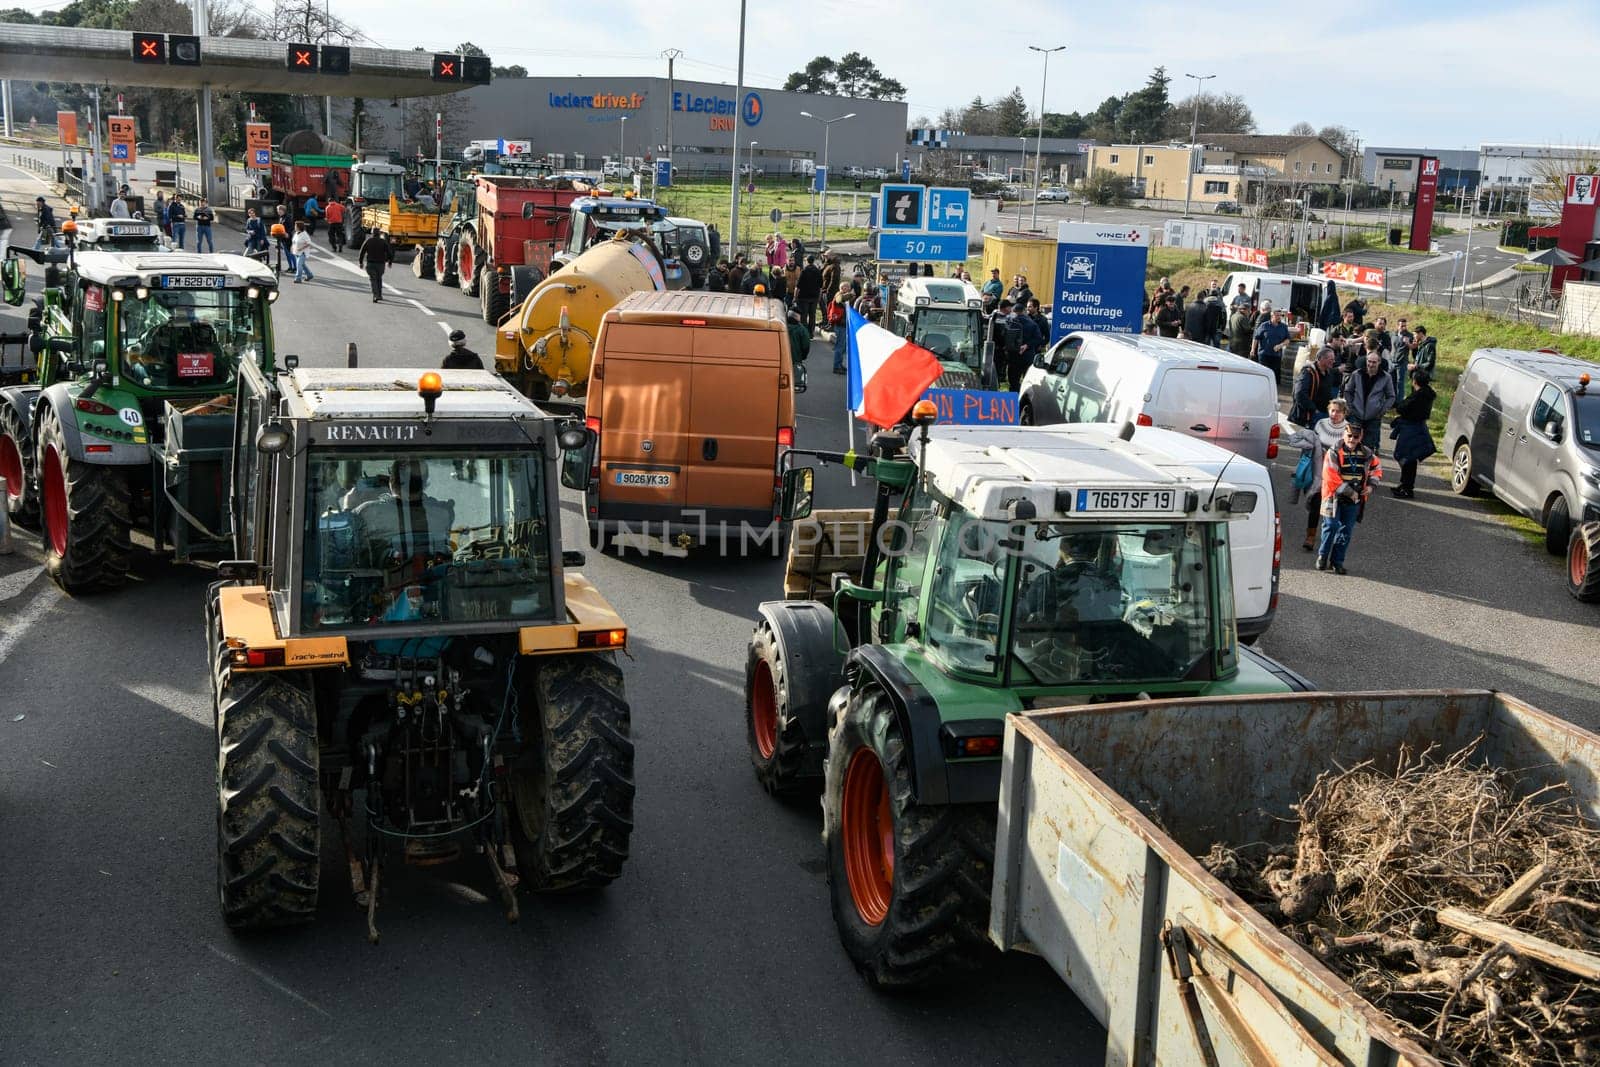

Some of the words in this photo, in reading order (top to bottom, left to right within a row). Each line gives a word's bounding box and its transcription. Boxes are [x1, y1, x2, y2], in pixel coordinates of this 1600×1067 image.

[548, 92, 645, 109] leclercdrive.fr
[709, 116, 736, 132] DRIV
[905, 240, 926, 255] 50
[929, 243, 943, 255] m
[1365, 271, 1383, 284] KFC
[1062, 291, 1102, 306] Parking
[1061, 303, 1123, 320] covoiturage
[1059, 322, 1082, 331] Gratuit
[1102, 324, 1110, 332] 72
[964, 393, 1015, 423] PLAN
[123, 410, 140, 424] 40
[326, 425, 418, 440] RENAULT
[623, 474, 645, 484] 9026
[658, 475, 669, 485] 33
[1092, 491, 1130, 509] 7667
[1130, 491, 1153, 509] SF
[1153, 491, 1170, 509] 19
